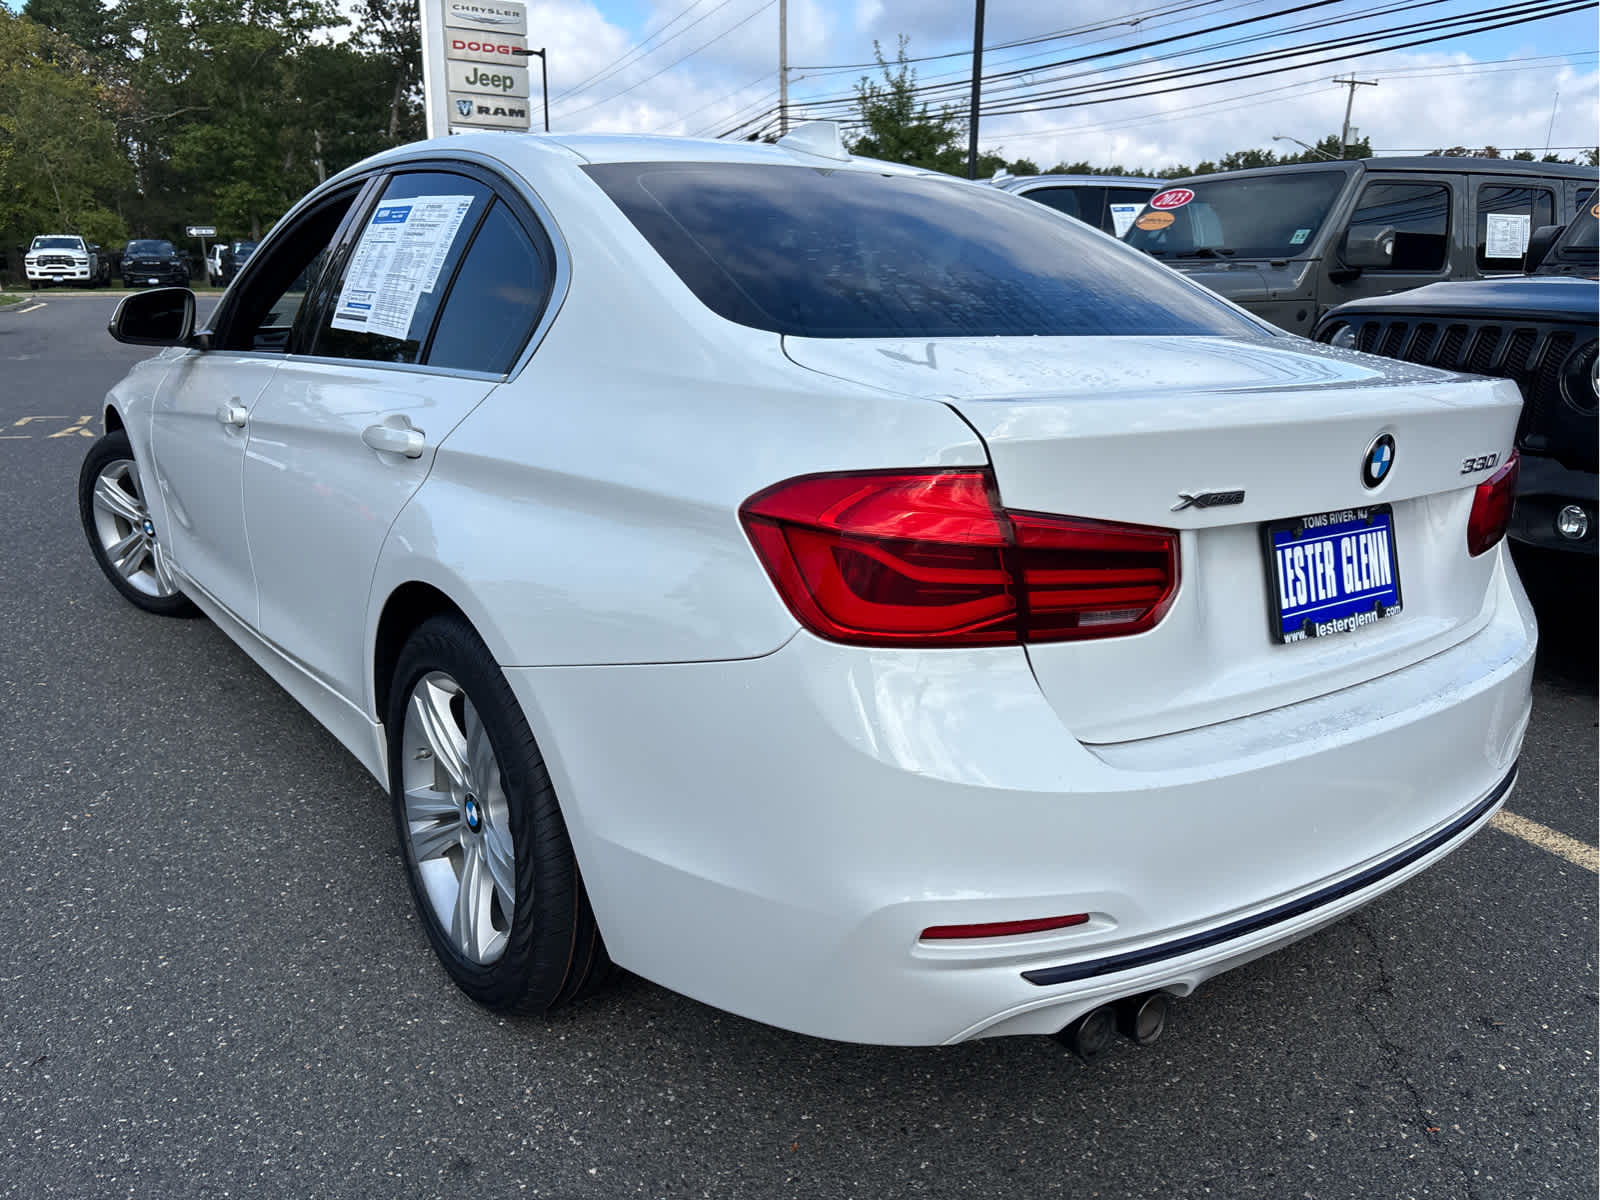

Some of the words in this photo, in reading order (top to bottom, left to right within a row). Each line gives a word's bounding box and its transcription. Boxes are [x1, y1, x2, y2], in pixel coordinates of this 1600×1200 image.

[452, 4, 520, 18] CHRYSLER
[465, 67, 514, 92] Jeep
[477, 105, 525, 118] RAM
[1155, 192, 1190, 206] 2023
[1460, 451, 1501, 474] 330i
[1302, 514, 1328, 529] TOMS
[1357, 509, 1368, 519] NJ
[1276, 540, 1337, 609] LESTER
[1340, 530, 1392, 594] GLENN
